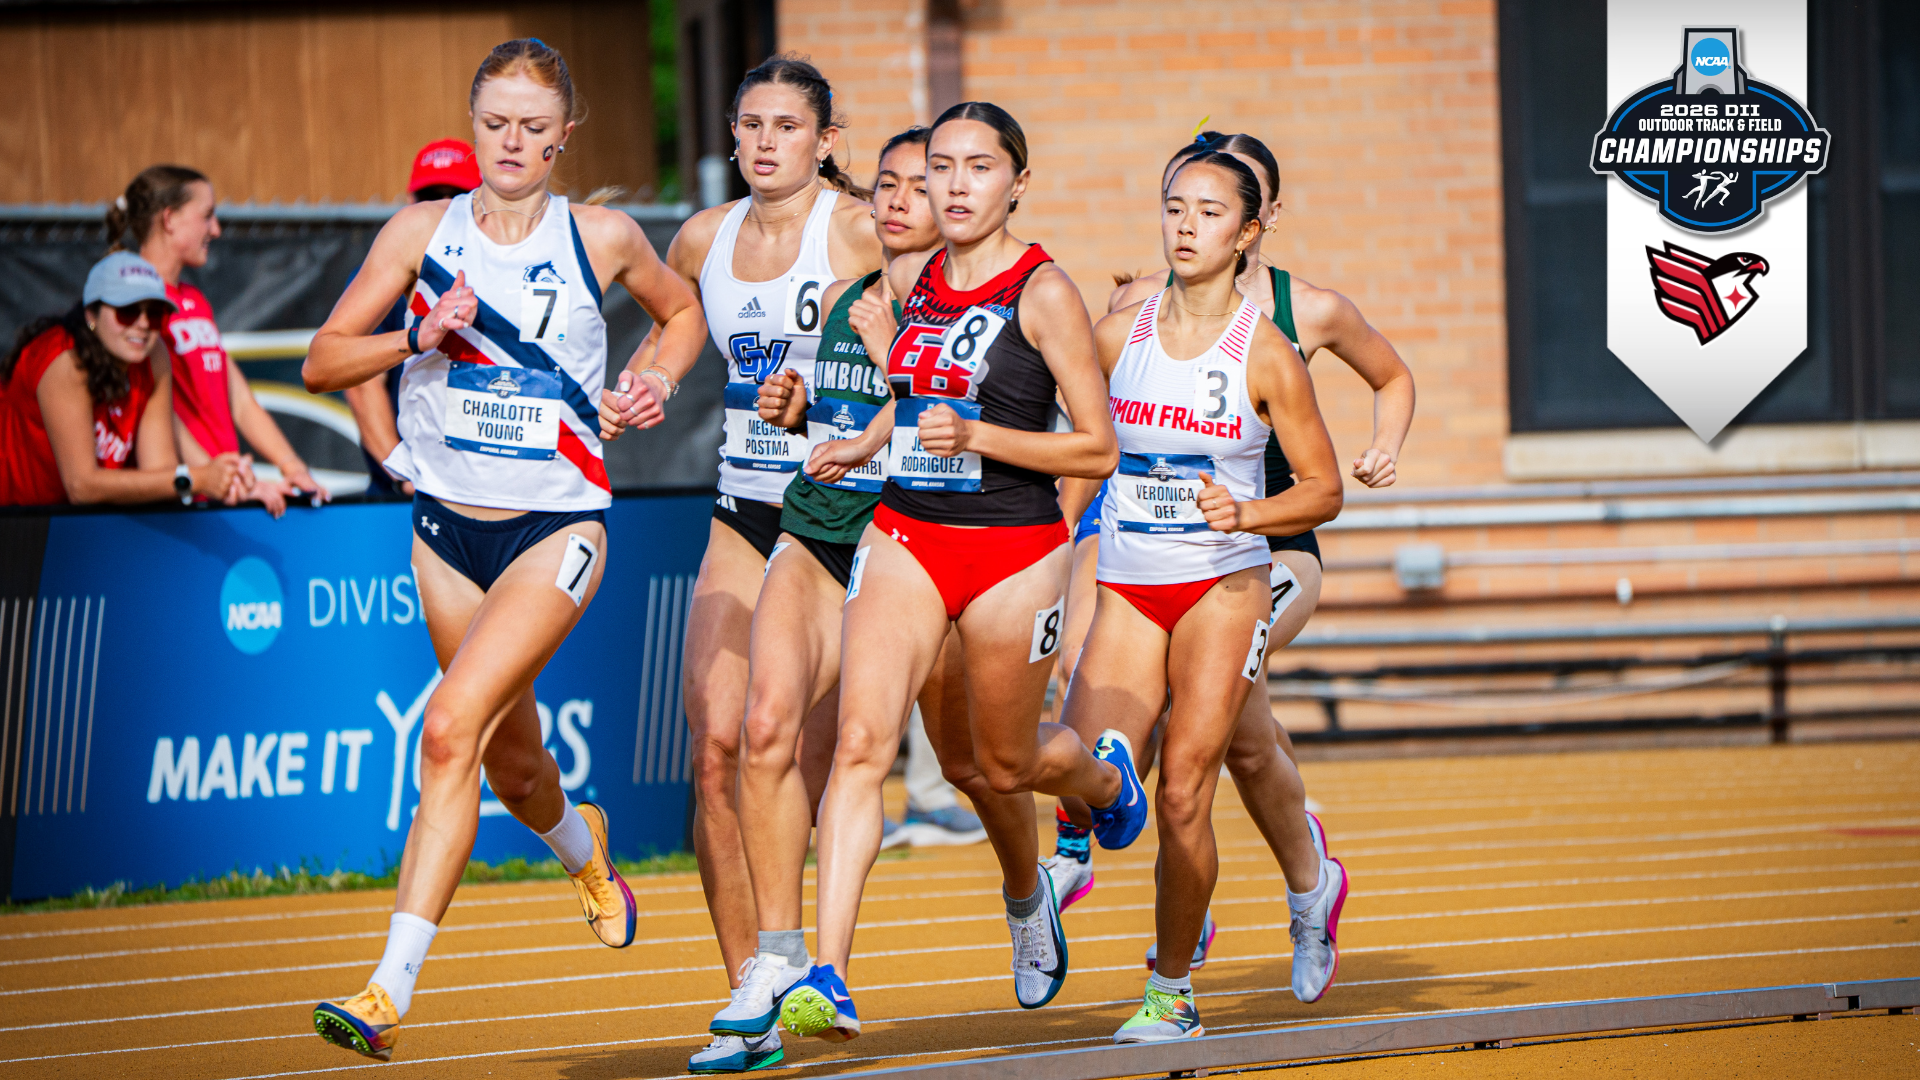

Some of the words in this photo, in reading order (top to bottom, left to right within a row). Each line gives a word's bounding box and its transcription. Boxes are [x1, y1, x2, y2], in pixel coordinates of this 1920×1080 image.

[533, 288, 557, 339] 7
[738, 310, 766, 318] adidas
[795, 280, 820, 332] 6
[833, 341, 850, 353] CAL
[850, 343, 869, 356] POL
[951, 314, 988, 362] 8
[463, 399, 543, 423] CHARLOTTE
[1202, 370, 1229, 419] 3
[477, 421, 524, 441] YOUNG
[1109, 396, 1156, 427] IMON
[1158, 405, 1242, 440] FRASER
[745, 438, 789, 456] POSTMA
[901, 456, 964, 474] RODRIGUEZ
[1136, 484, 1197, 502] VERONICA
[1154, 505, 1177, 519] DEE
[567, 543, 593, 592] 7
[227, 601, 282, 630] NCAA
[1040, 609, 1060, 655] 8
[1248, 628, 1267, 678] 3
[147, 731, 309, 804] MAKE
[320, 729, 374, 794] IT
